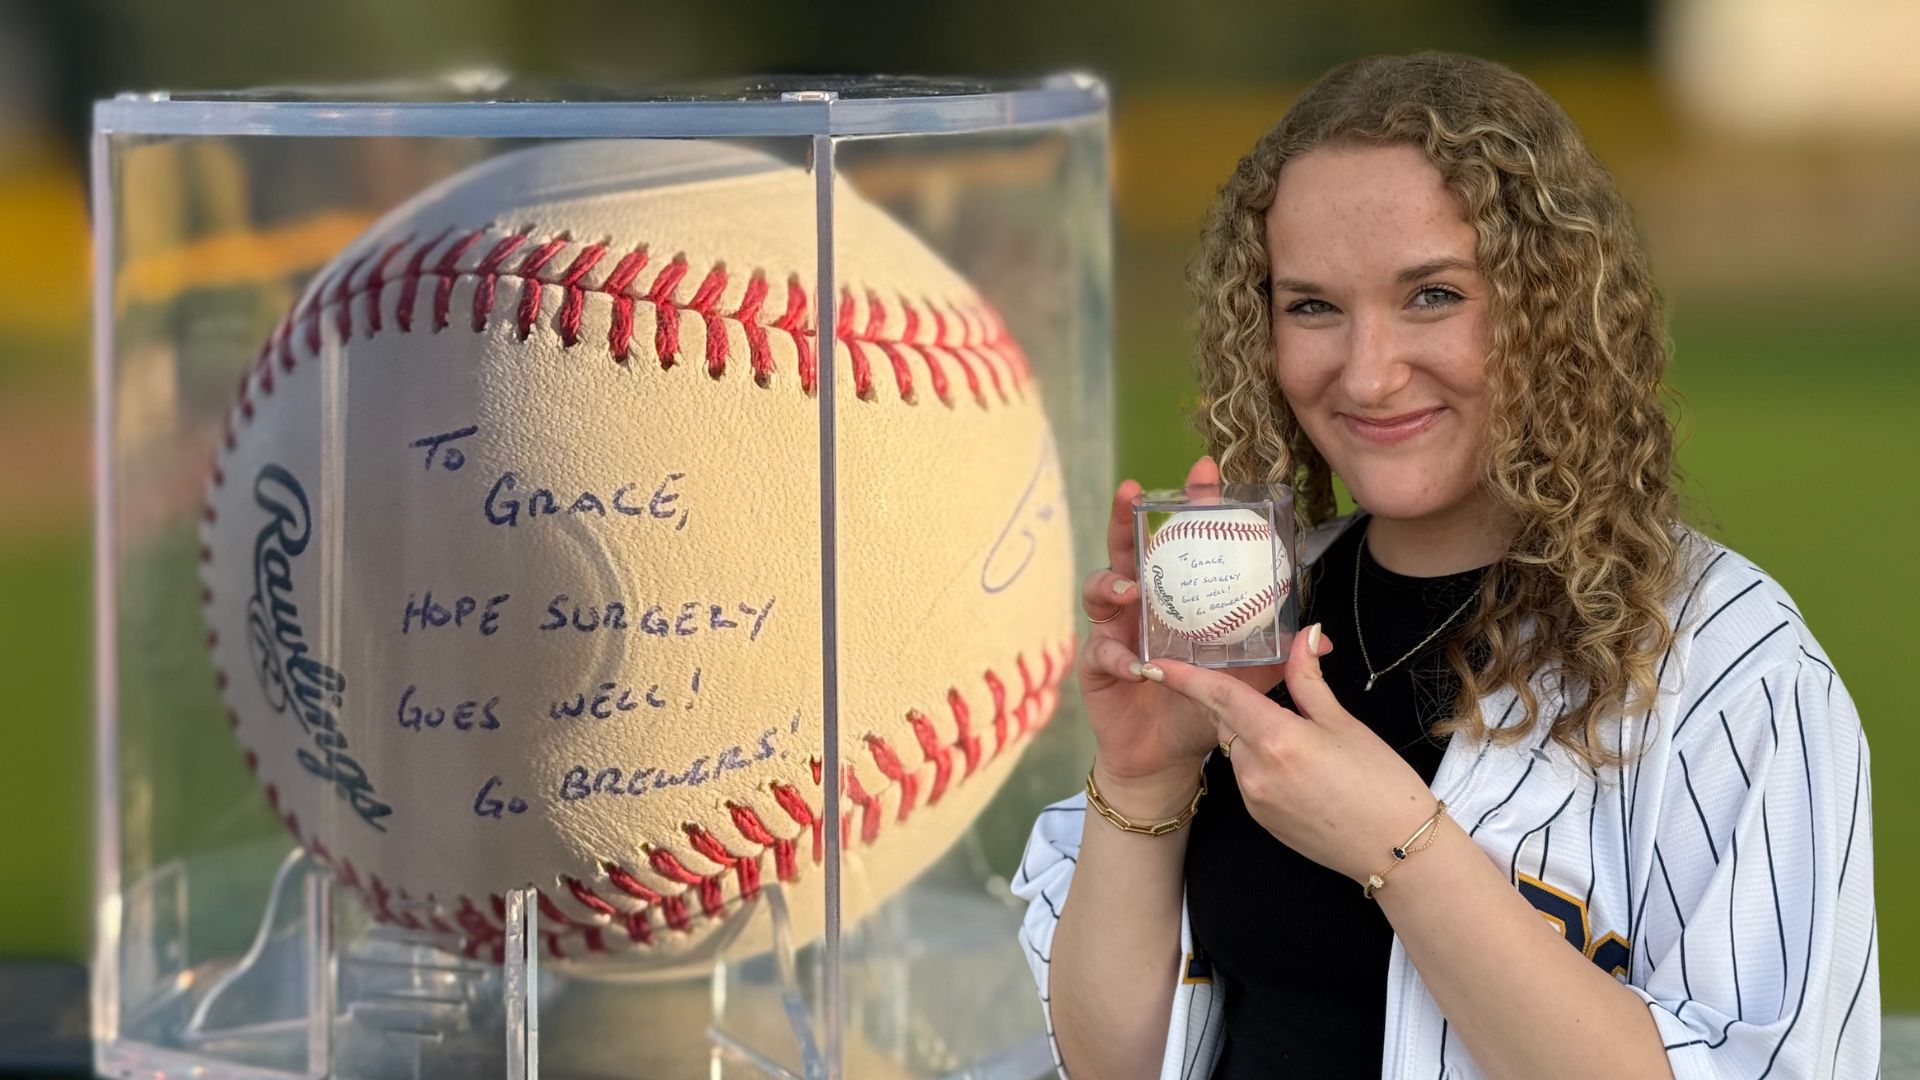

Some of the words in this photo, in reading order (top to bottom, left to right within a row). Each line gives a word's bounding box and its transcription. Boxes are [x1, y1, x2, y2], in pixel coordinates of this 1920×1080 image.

[401, 590, 510, 636] HOPE
[539, 593, 776, 641] SURGERY
[1152, 564, 1184, 622] Rawlings
[250, 463, 393, 834] Rawlings
[397, 685, 501, 732] GOES
[558, 707, 801, 801] BREWERS!
